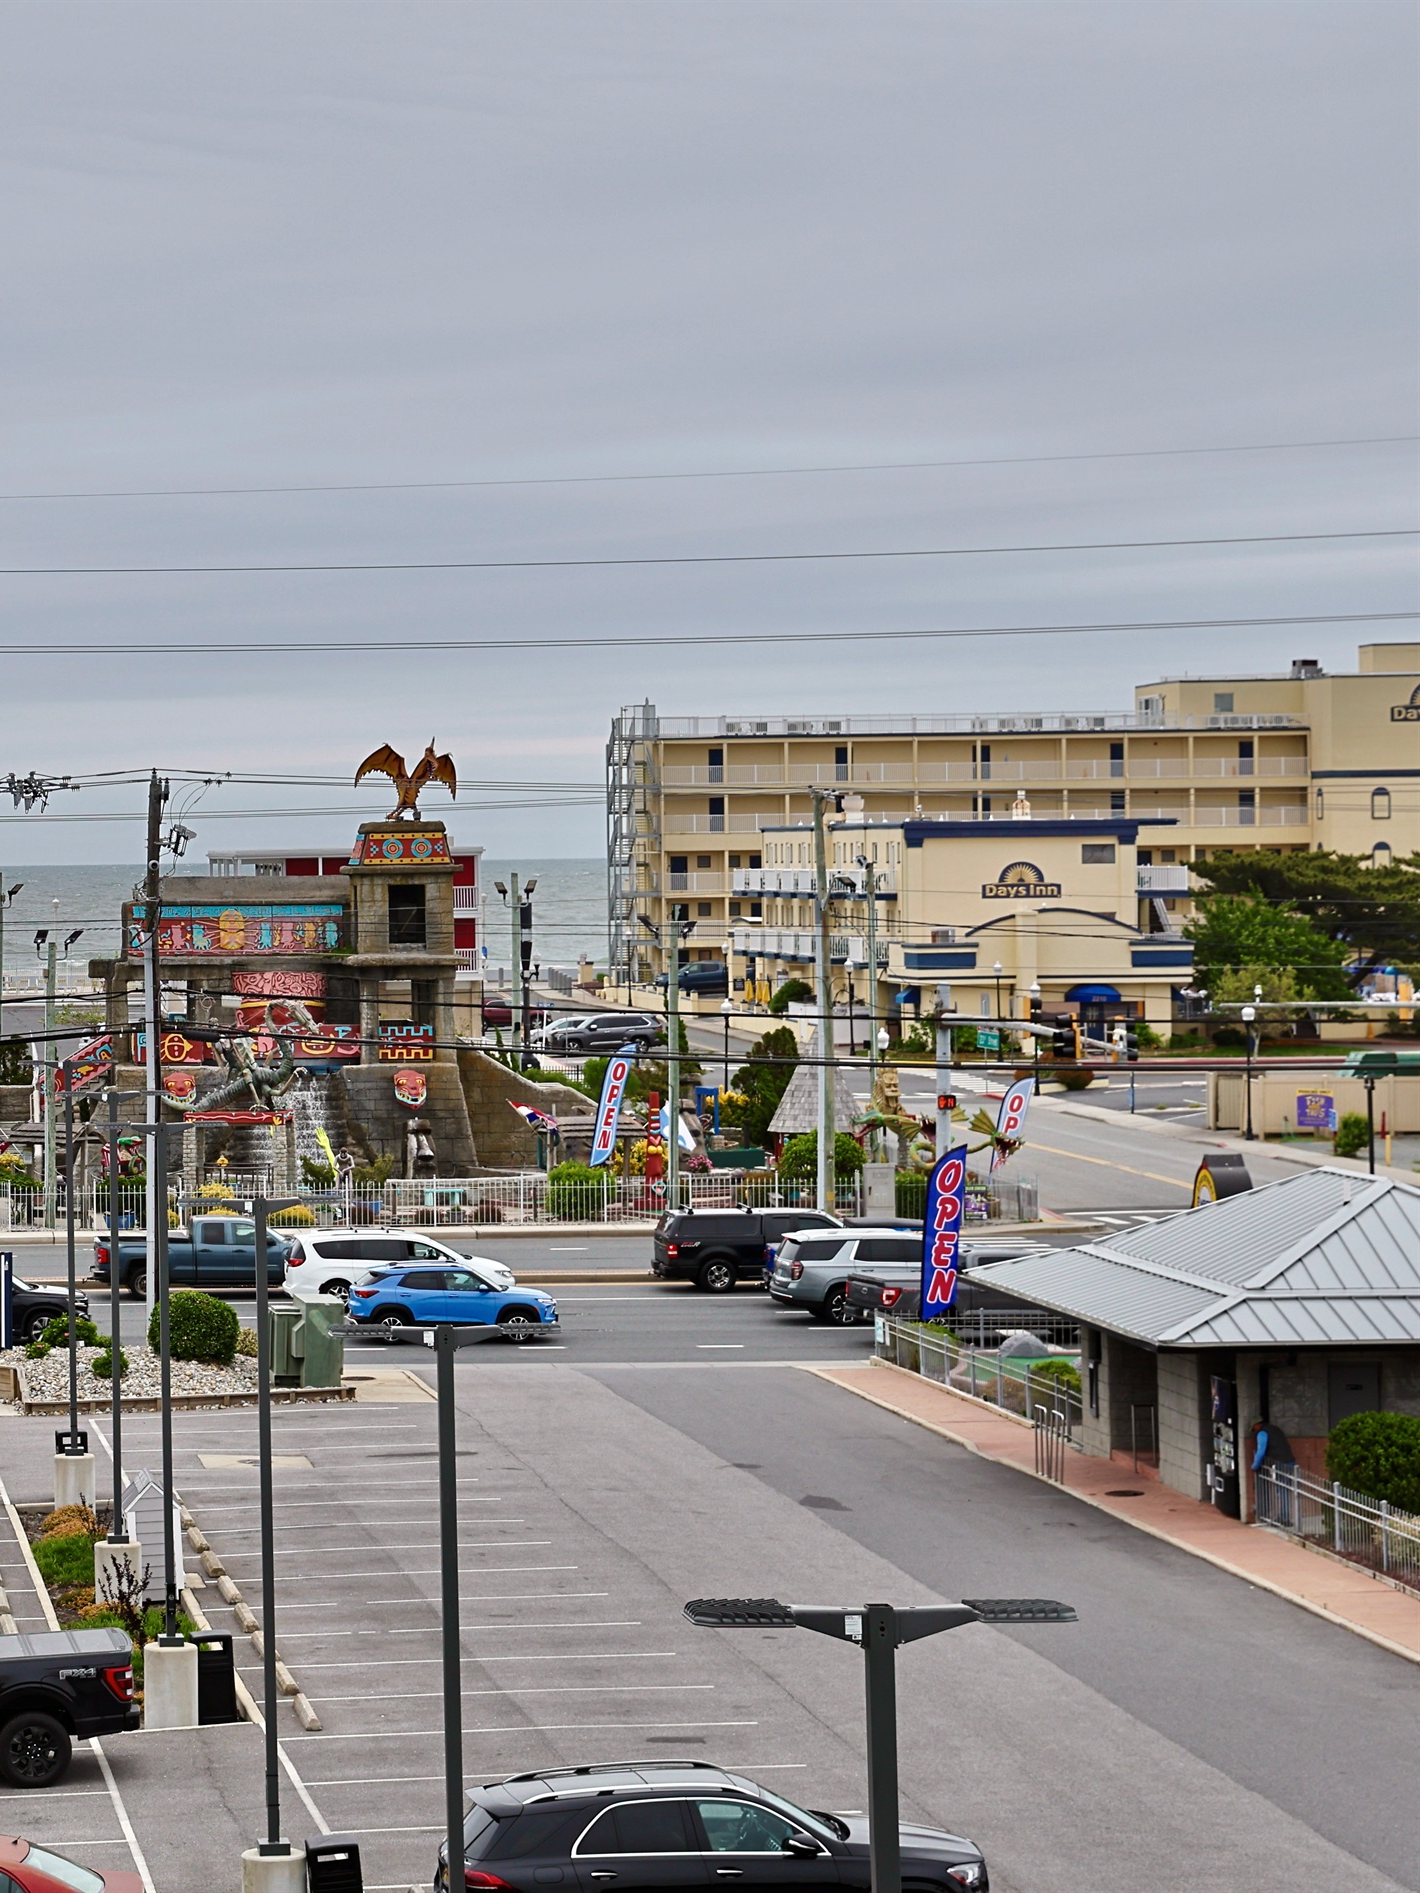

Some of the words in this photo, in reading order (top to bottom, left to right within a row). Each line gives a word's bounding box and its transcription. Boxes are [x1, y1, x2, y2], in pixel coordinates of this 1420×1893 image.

[1393, 707, 1420, 720] Da
[985, 885, 1026, 898] Days
[1029, 884, 1058, 896] Inn
[596, 1060, 627, 1151] OPEN
[926, 1159, 964, 1304] OPEN
[60, 1668, 96, 1680] FX4
